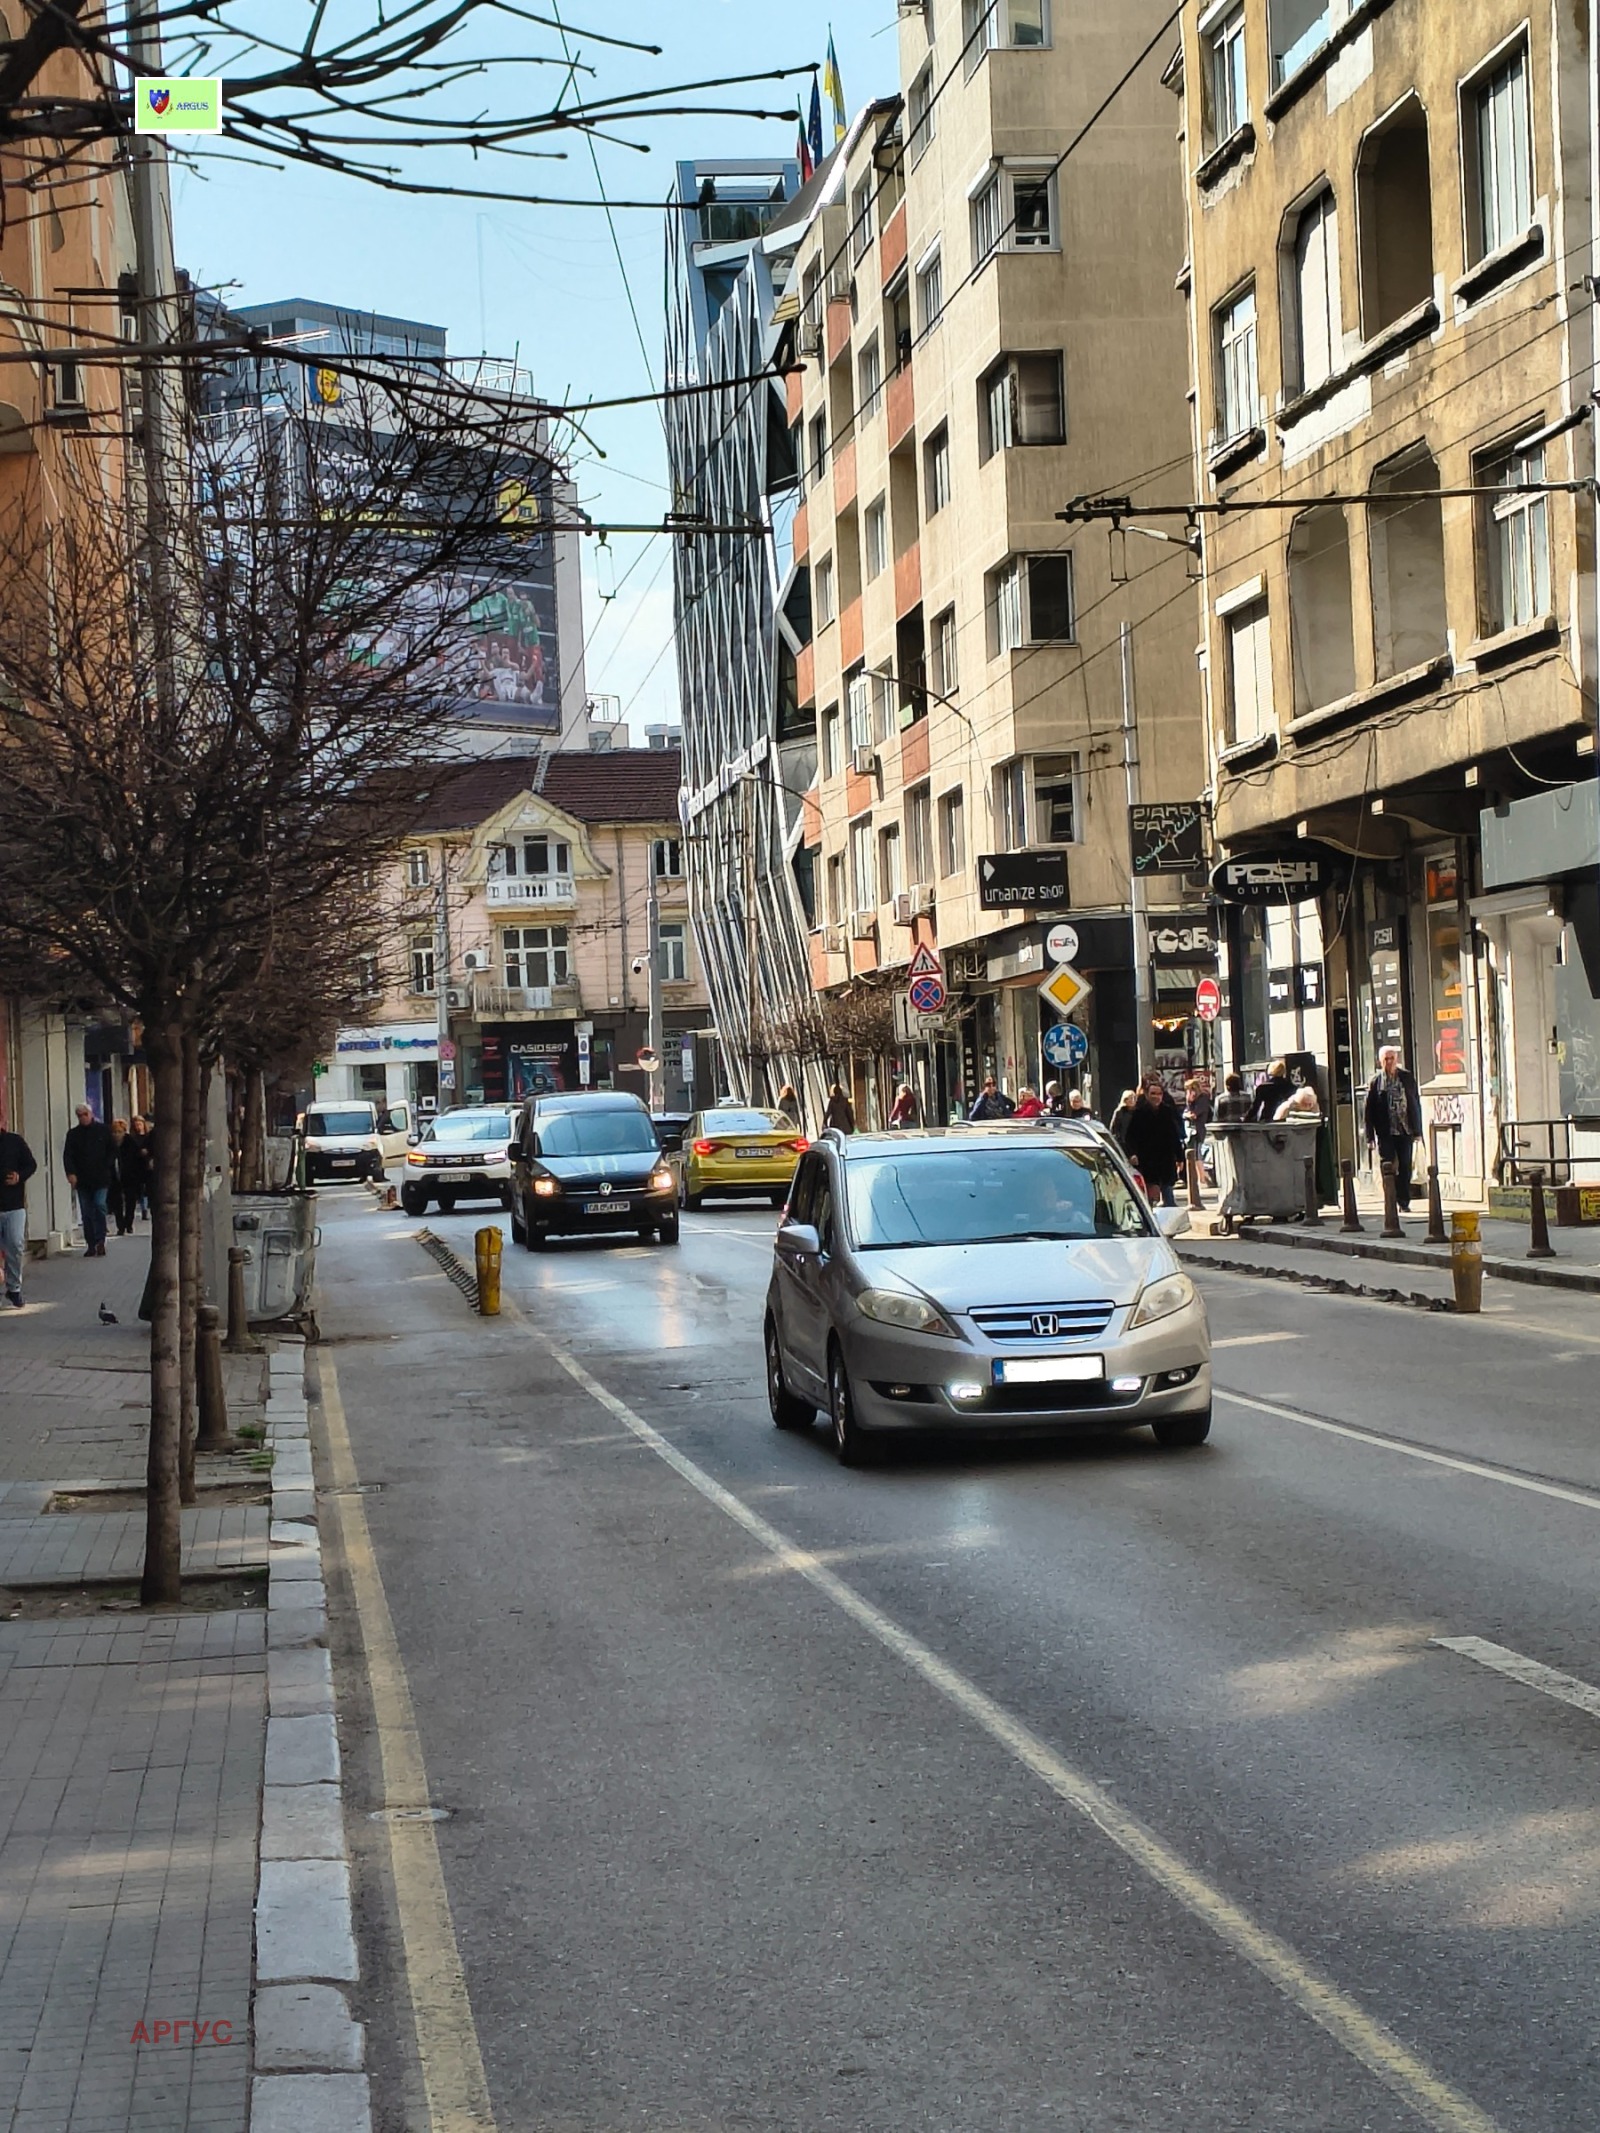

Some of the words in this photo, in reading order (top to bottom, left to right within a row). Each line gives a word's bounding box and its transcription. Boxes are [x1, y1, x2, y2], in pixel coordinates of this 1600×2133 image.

[1226, 861, 1319, 885] POSH
[1237, 884, 1309, 895] OUTLET
[510, 1043, 545, 1053] CASIO
